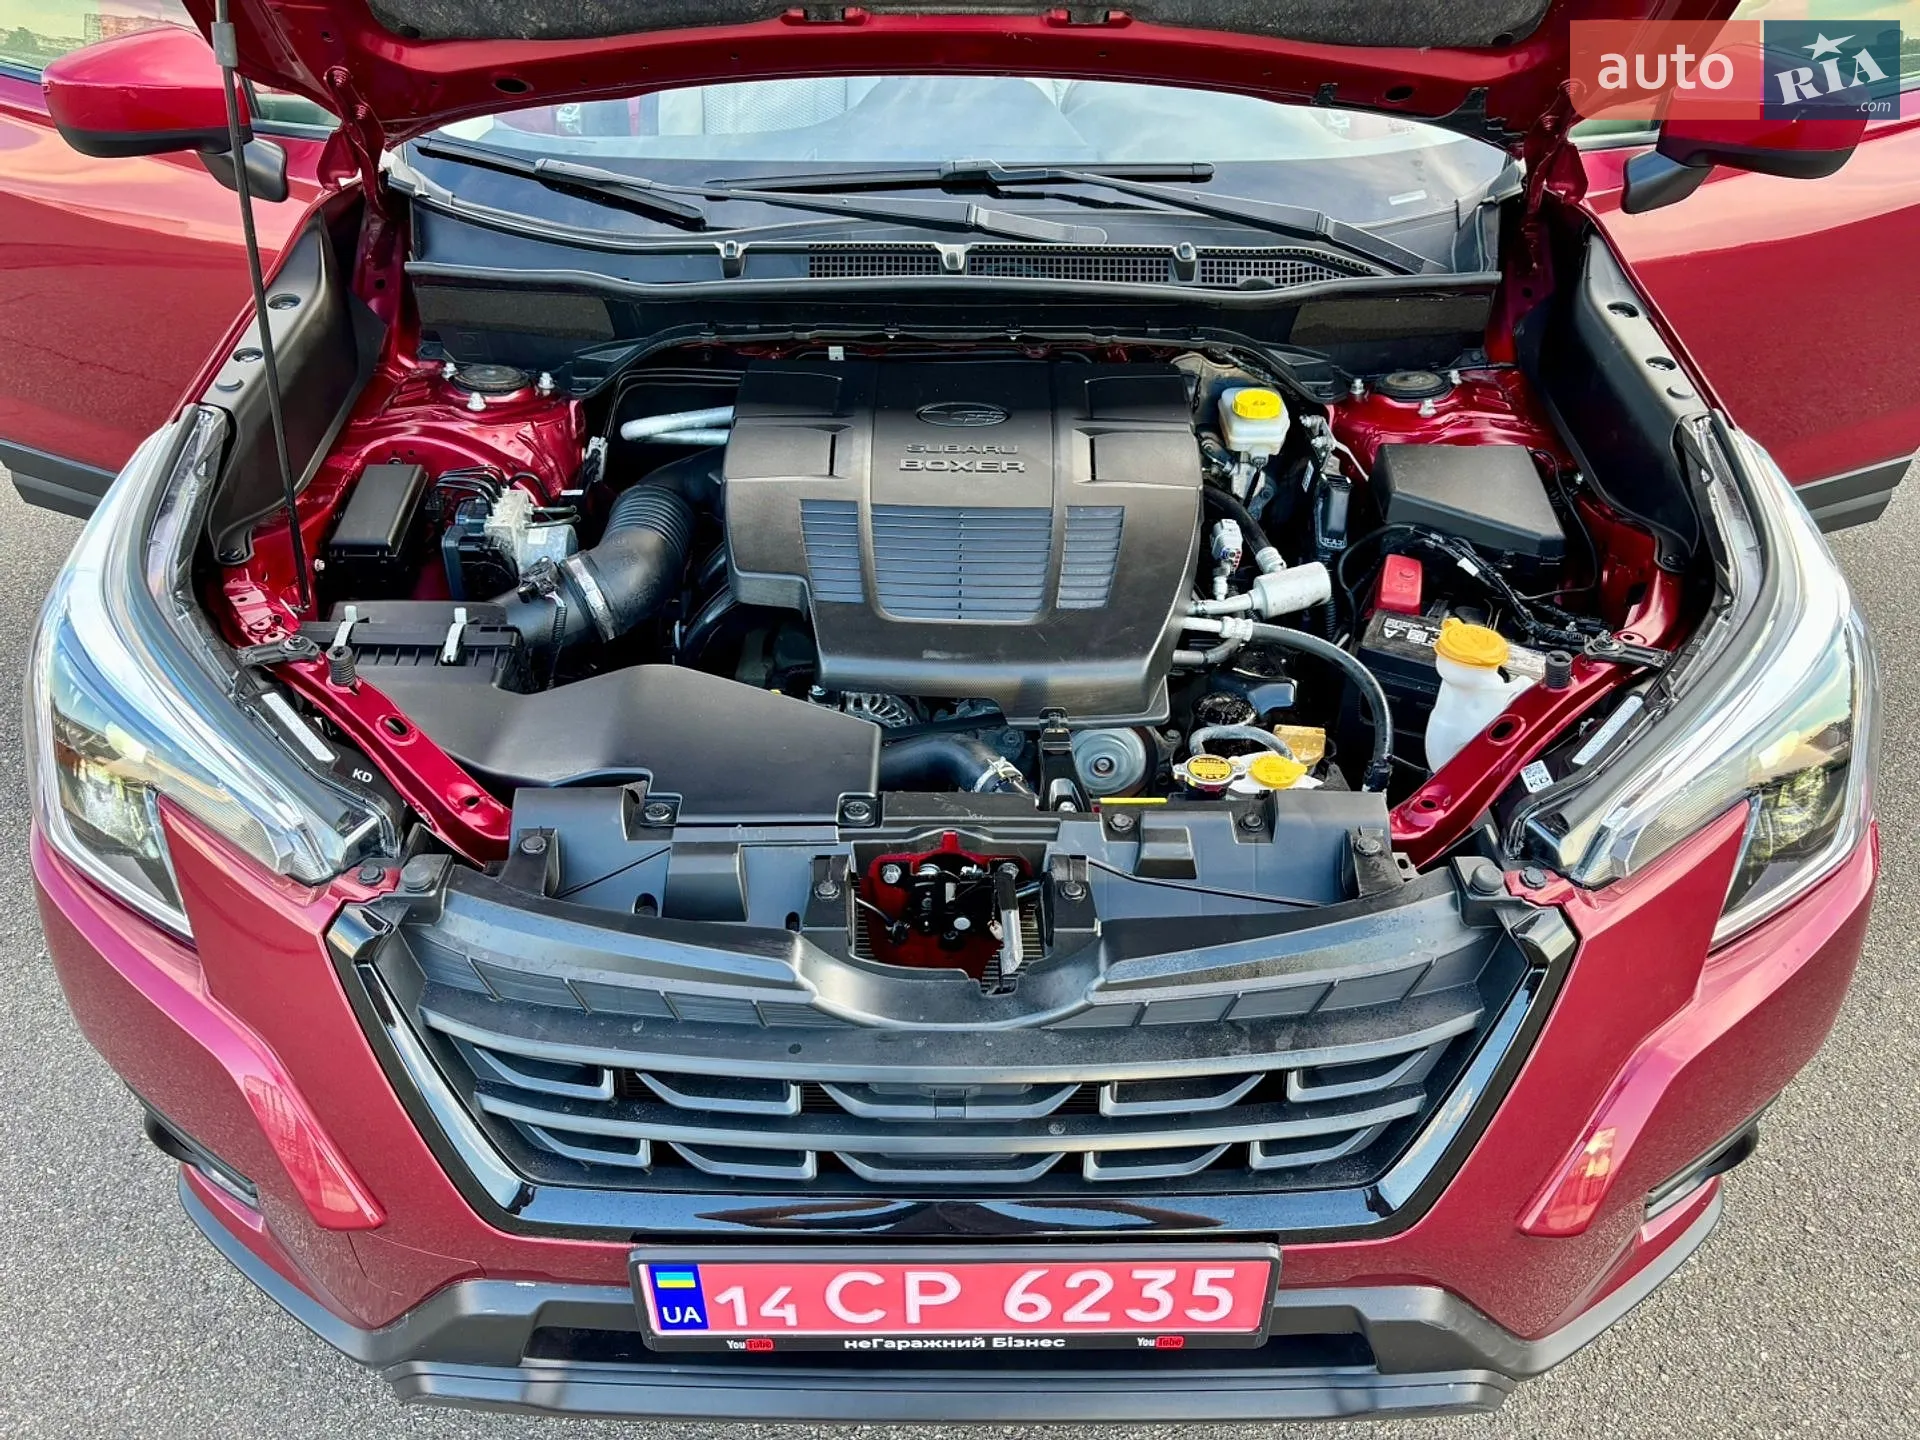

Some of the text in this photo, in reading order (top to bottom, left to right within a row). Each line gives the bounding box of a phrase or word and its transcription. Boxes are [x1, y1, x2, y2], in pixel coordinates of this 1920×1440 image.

[906, 443, 1019, 455] SUBARU
[900, 458, 1025, 473] BOXER
[352, 768, 373, 783] KD
[713, 1268, 1235, 1326] 14 CP 6235
[662, 1306, 702, 1323] UA
[844, 1336, 1066, 1350] неГаражний Бізнес
